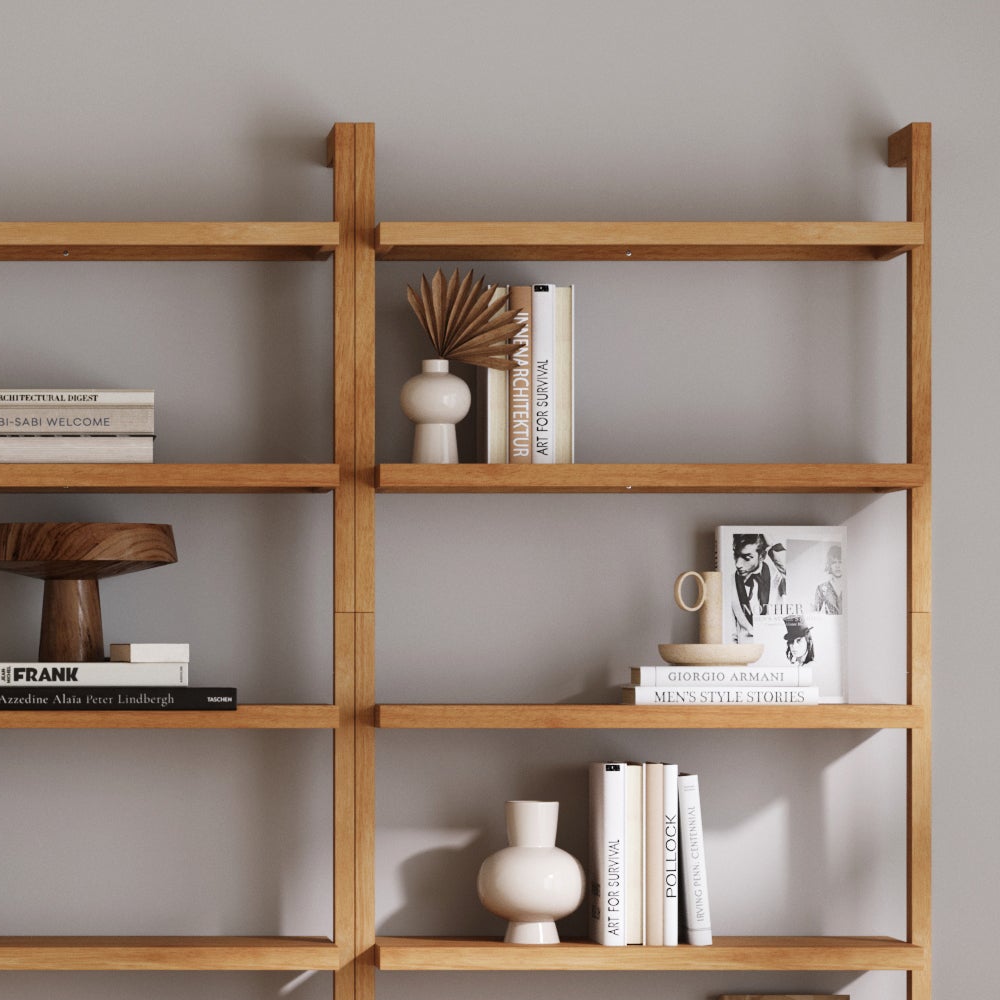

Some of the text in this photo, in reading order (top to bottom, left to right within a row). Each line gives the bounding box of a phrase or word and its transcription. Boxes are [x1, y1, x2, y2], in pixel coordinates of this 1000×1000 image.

[67, 394, 99, 402] DIGEST
[536, 360, 549, 456] ART FOR SURVIVAL
[46, 417, 111, 427] WELCOME
[13, 667, 79, 682] FRANK
[668, 672, 785, 682] GIORGIO ARMANI
[86, 694, 114, 705] Peter
[117, 693, 175, 708] Lindbergh
[655, 691, 805, 703] MEN'S STYLE STORIES
[665, 814, 677, 898] POLLOCK
[607, 840, 620, 936] ART FOR SURVIVAL
